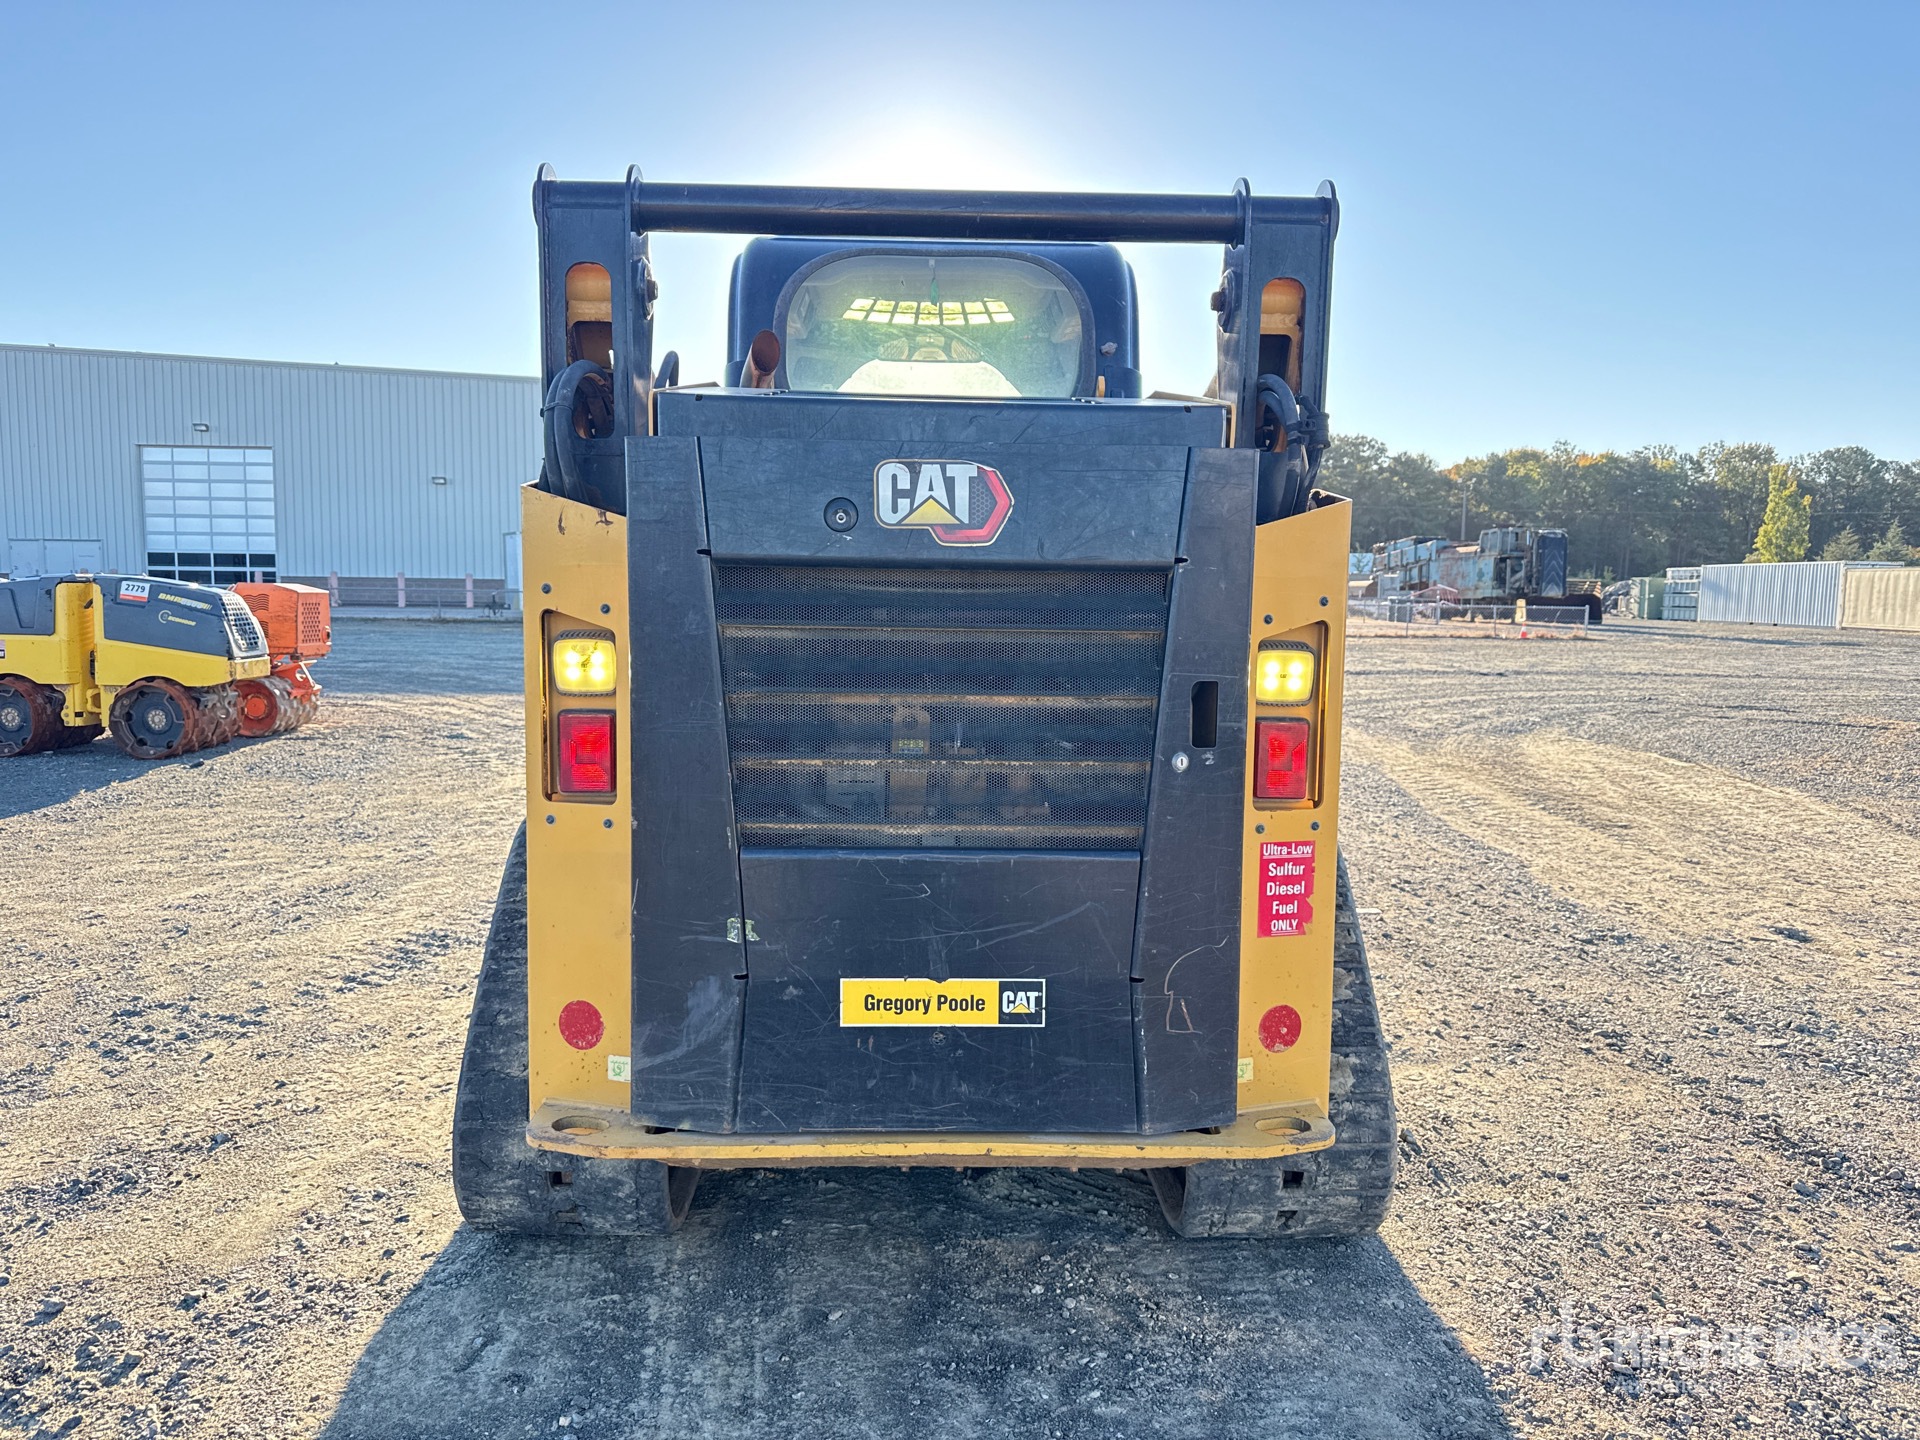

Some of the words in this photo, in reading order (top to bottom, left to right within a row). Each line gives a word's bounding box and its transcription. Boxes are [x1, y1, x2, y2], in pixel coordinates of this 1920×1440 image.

[878, 462, 978, 524] CAT
[124, 583, 146, 593] 2779
[1263, 843, 1313, 856] Ultra-Low
[1268, 862, 1305, 876] Sulfur
[1266, 881, 1305, 896] Diesel
[1272, 900, 1298, 914] Fuel
[1271, 919, 1298, 931] ONLY
[864, 994, 931, 1015] Gregory
[937, 994, 986, 1011] Poole
[1002, 990, 1039, 1014] CAT
